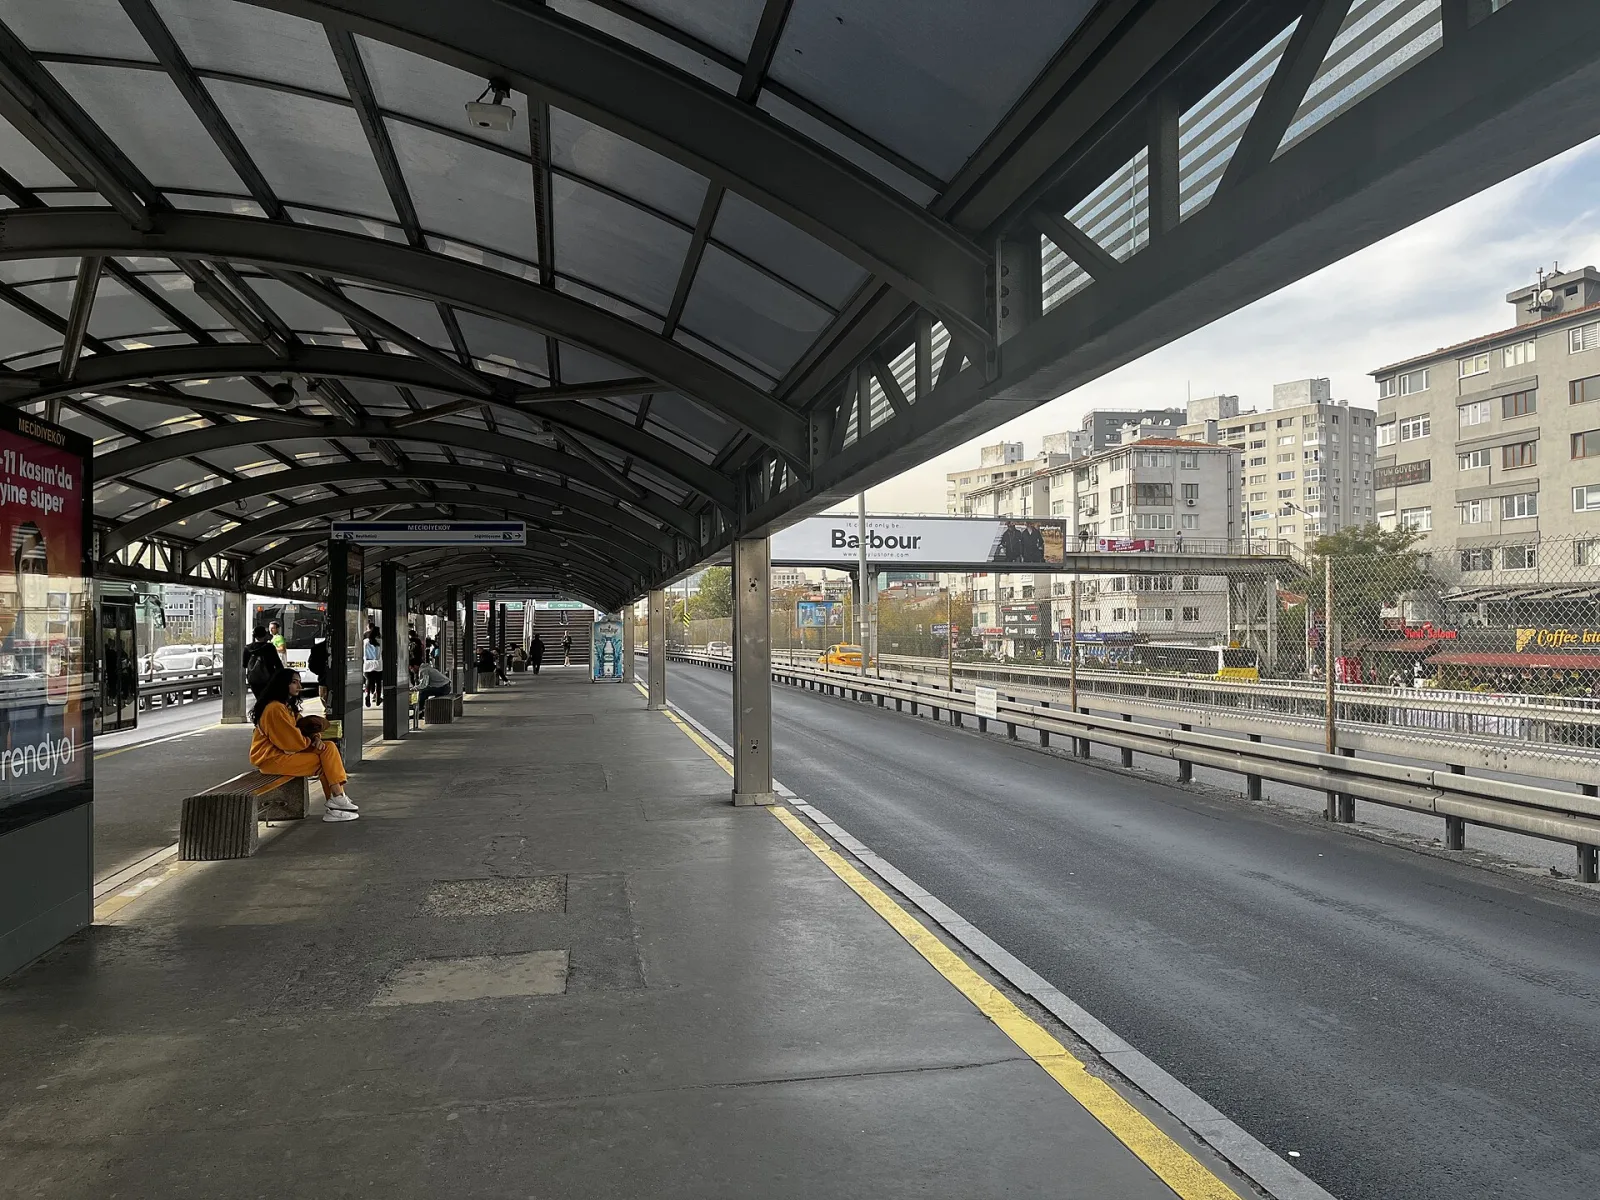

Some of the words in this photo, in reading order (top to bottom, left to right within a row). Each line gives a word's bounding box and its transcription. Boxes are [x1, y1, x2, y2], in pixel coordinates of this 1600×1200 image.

[18, 418, 66, 446] MECİDİYEKÖY
[20, 453, 73, 490] kasım'da
[30, 485, 64, 516] süper
[1537, 628, 1578, 648] Coffee
